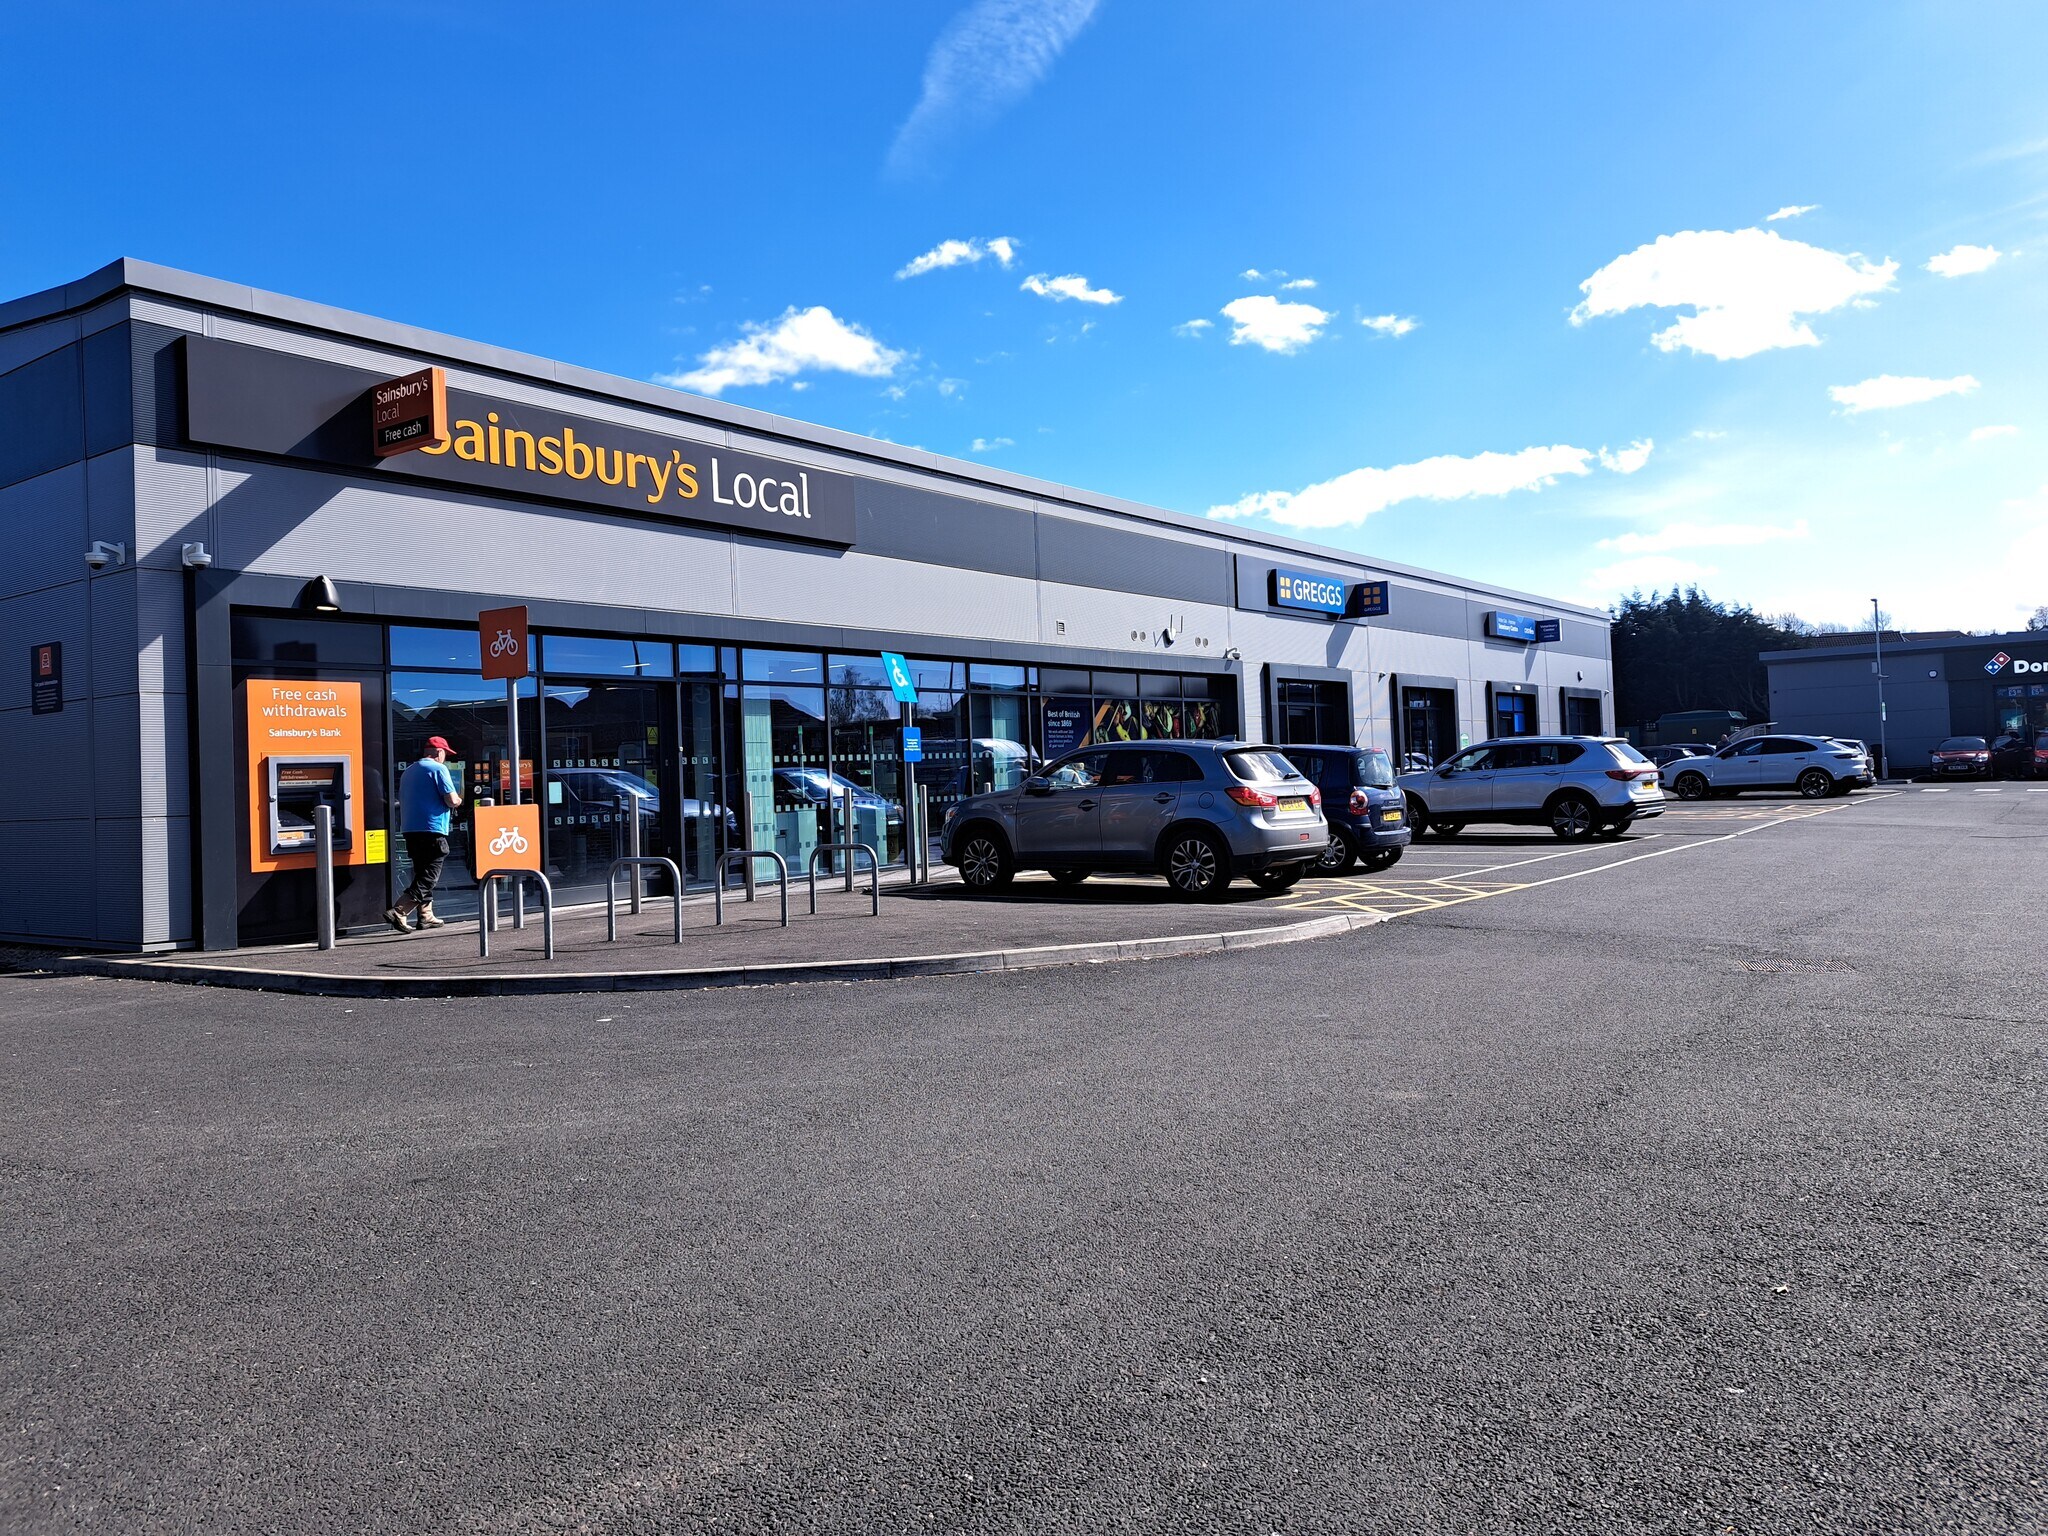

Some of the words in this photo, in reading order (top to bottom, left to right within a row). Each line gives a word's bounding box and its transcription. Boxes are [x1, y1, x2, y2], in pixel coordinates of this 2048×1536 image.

[376, 377, 428, 405] Sainsbury's
[377, 403, 400, 423] Local
[385, 429, 402, 442] Free
[403, 421, 422, 437] cash
[711, 457, 812, 519] Local
[1293, 579, 1342, 607] GREGGS
[2013, 659, 2048, 674] Do
[271, 687, 302, 701] Free
[305, 688, 337, 702] cash
[262, 704, 348, 718] withdrawals
[1047, 710, 1058, 718] Best
[1058, 710, 1065, 718] of
[1065, 710, 1081, 718] British
[1047, 719, 1060, 727] since
[268, 728, 318, 739] Sainsbury's
[320, 728, 342, 738] Bank
